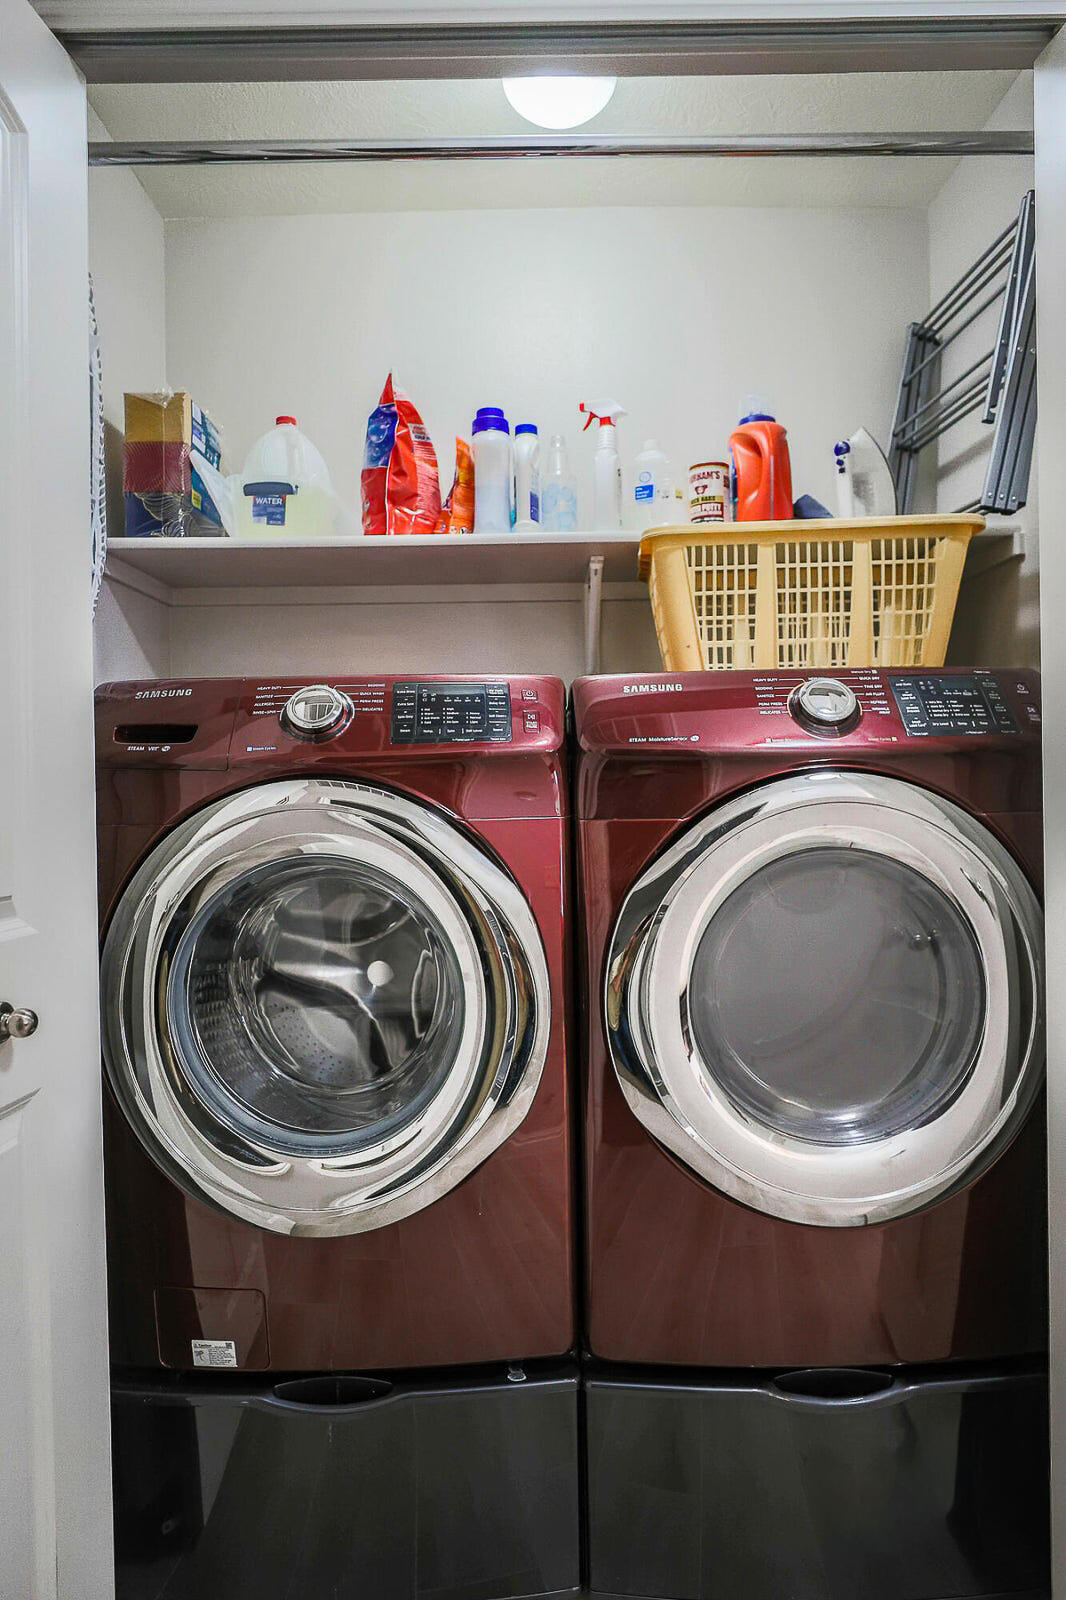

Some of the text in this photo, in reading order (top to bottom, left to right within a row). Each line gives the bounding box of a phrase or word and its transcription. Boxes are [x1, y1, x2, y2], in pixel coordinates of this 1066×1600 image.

[255, 497, 283, 505] WATER
[623, 683, 683, 693] SAMSUNG
[135, 688, 193, 699] SAMSUNG
